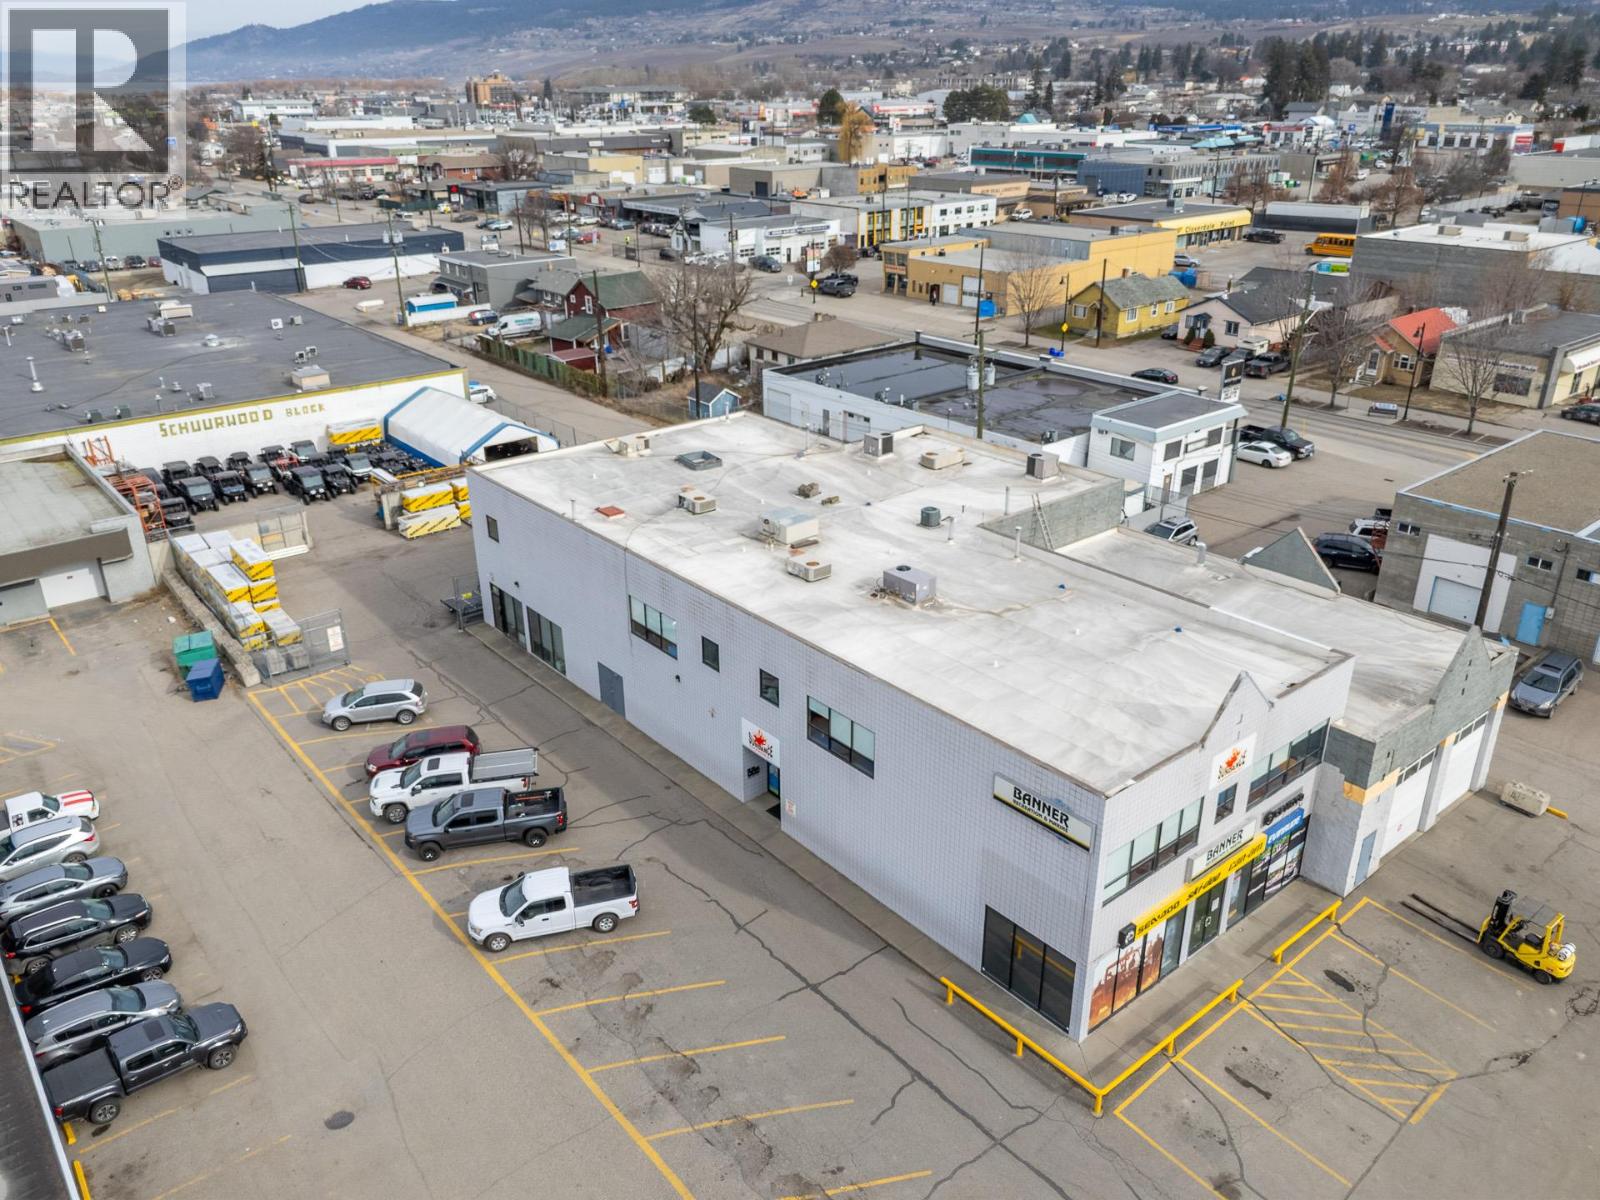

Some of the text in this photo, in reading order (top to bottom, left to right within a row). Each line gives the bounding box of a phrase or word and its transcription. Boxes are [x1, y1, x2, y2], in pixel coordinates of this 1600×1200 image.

[1185, 220, 1235, 233] Cloverdale Paint
[1013, 786, 1069, 828] BANNER
[1206, 829, 1244, 861] BANNER
